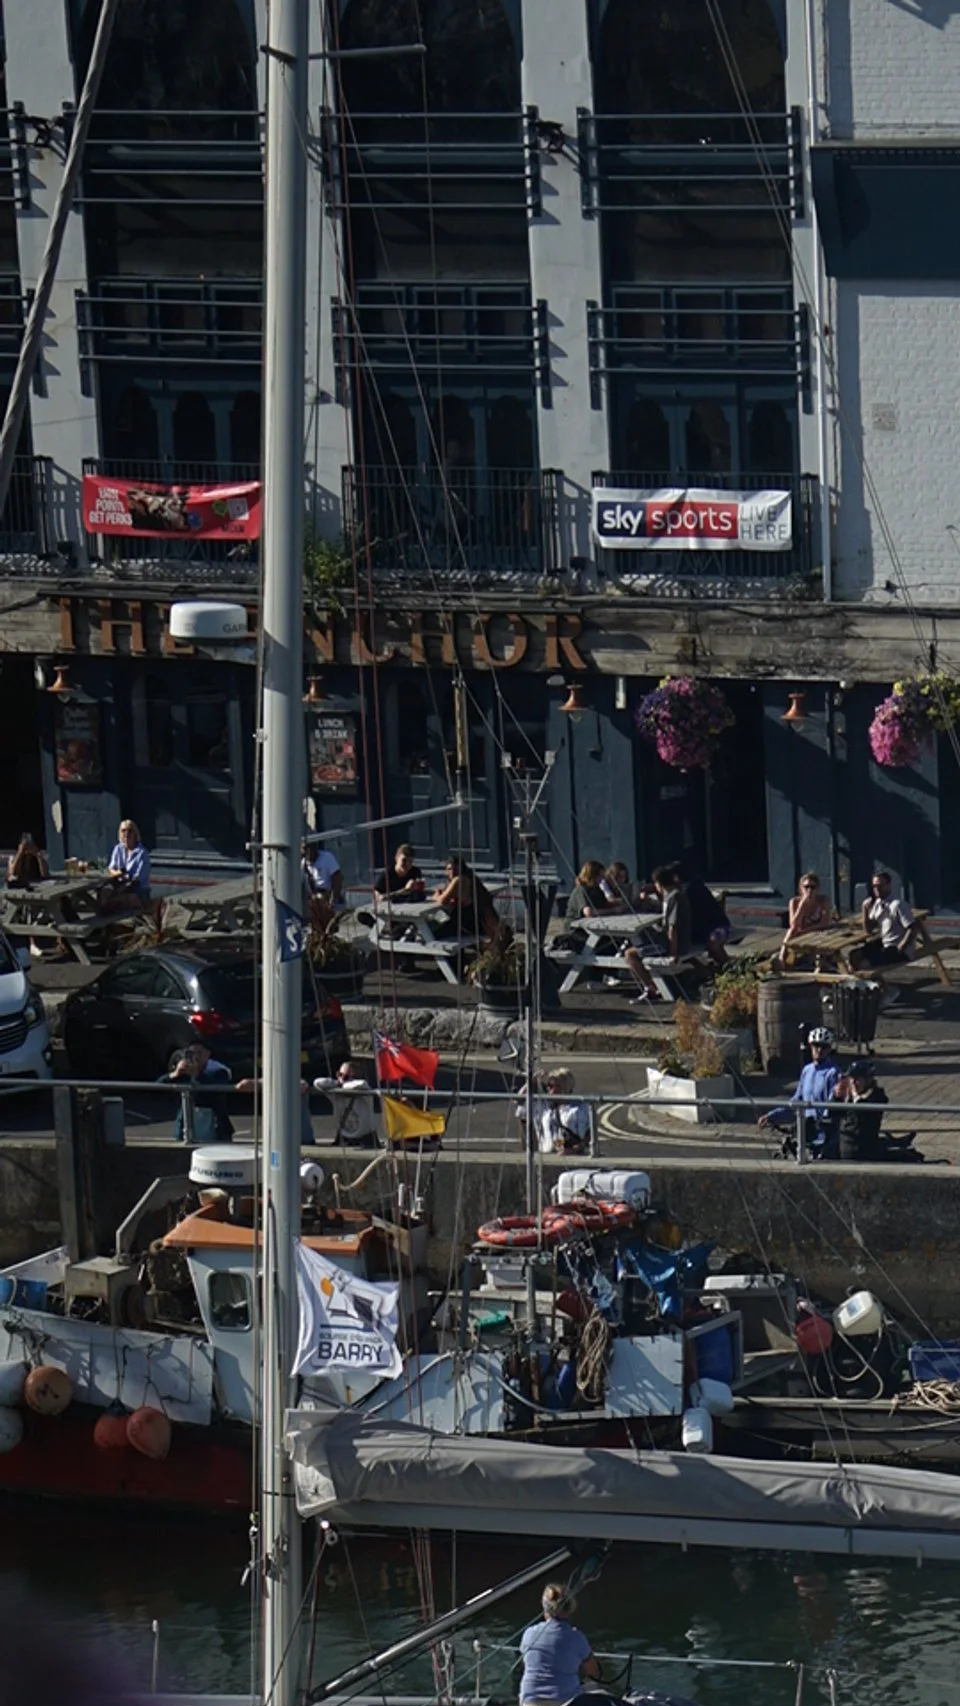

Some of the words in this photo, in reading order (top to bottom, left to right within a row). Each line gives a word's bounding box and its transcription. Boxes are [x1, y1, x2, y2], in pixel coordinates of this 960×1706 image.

[89, 511, 105, 524] GET
[105, 512, 133, 526] PERKS
[602, 504, 643, 535] sky
[651, 508, 732, 534] sports
[740, 505, 778, 522] LIVE
[740, 523, 788, 541] HERE
[245, 605, 587, 669] NCHOR
[318, 1341, 384, 1363] BARRY
